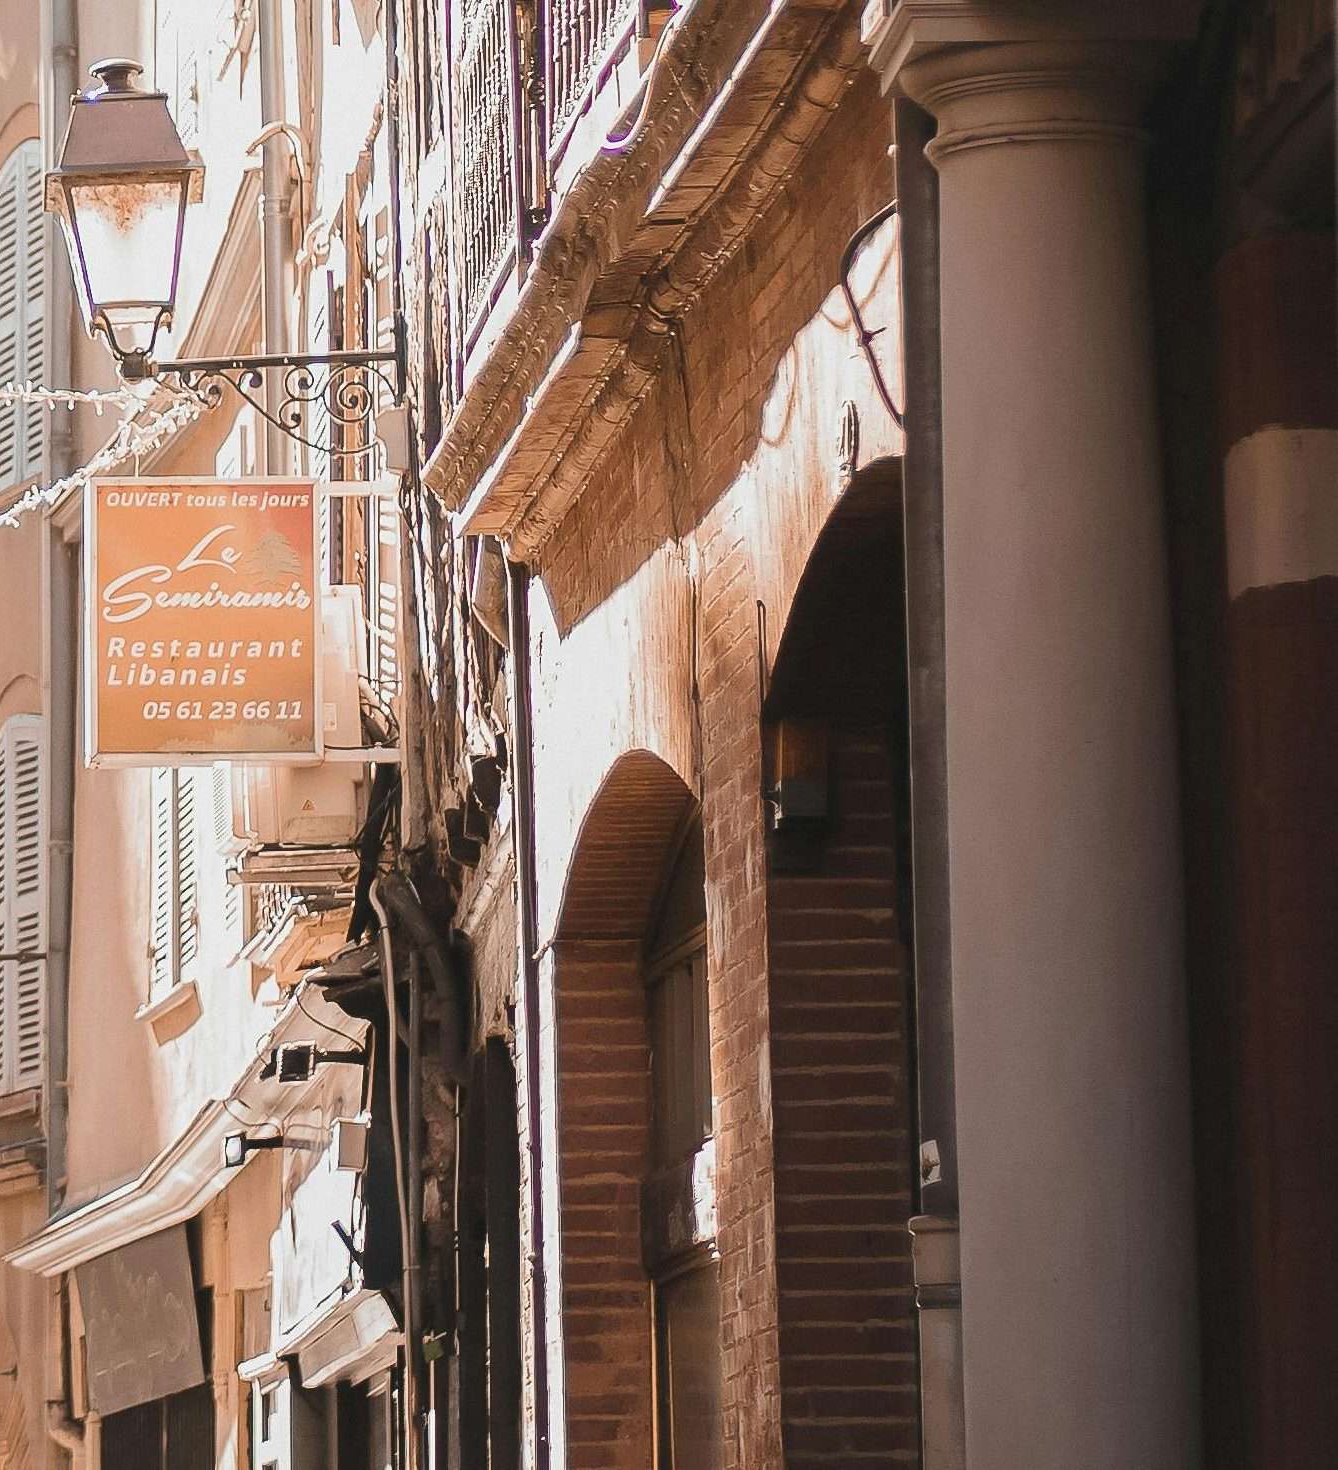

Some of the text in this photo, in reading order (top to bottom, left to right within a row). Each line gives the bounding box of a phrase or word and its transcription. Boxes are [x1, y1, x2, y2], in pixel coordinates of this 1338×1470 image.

[106, 491, 310, 511] OUVERT tous les jours
[176, 524, 243, 574] Le
[103, 564, 311, 623] Semiramis
[107, 637, 303, 658] Restaurant
[107, 663, 247, 686] Libanais
[142, 701, 302, 720] 05 61 23 66 11
